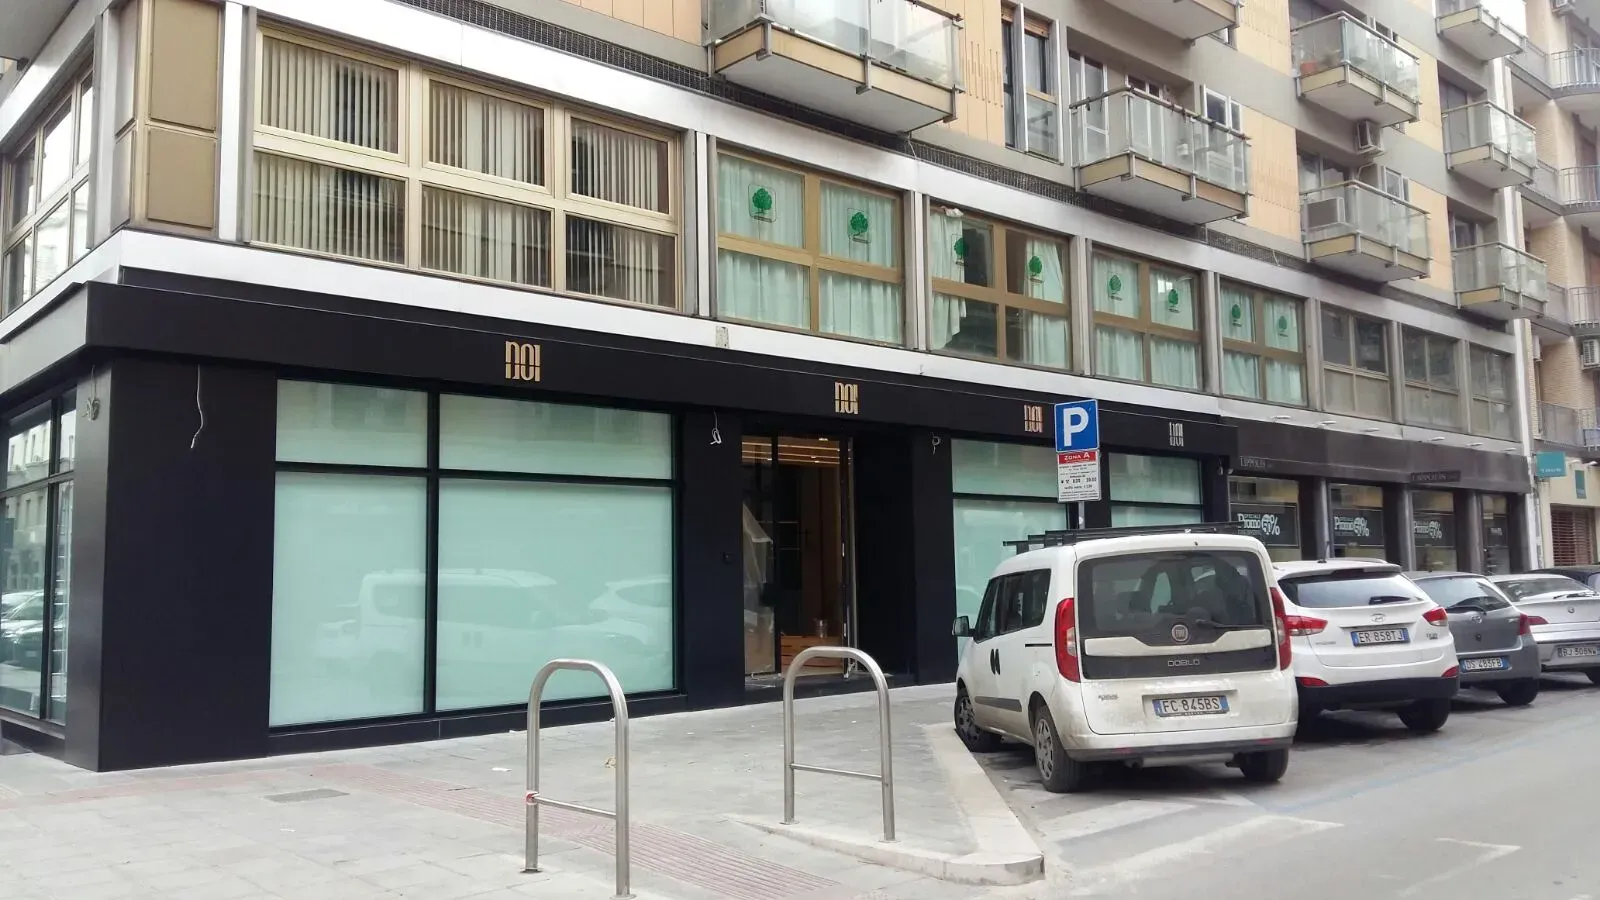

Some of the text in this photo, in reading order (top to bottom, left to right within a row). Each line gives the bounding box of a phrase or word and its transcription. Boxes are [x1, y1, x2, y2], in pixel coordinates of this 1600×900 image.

[1062, 406, 1090, 447] P
[1083, 451, 1090, 459] A
[1358, 632, 1371, 643] ER
[1162, 699, 1179, 713] FC
[1181, 697, 1221, 712] 845BS
